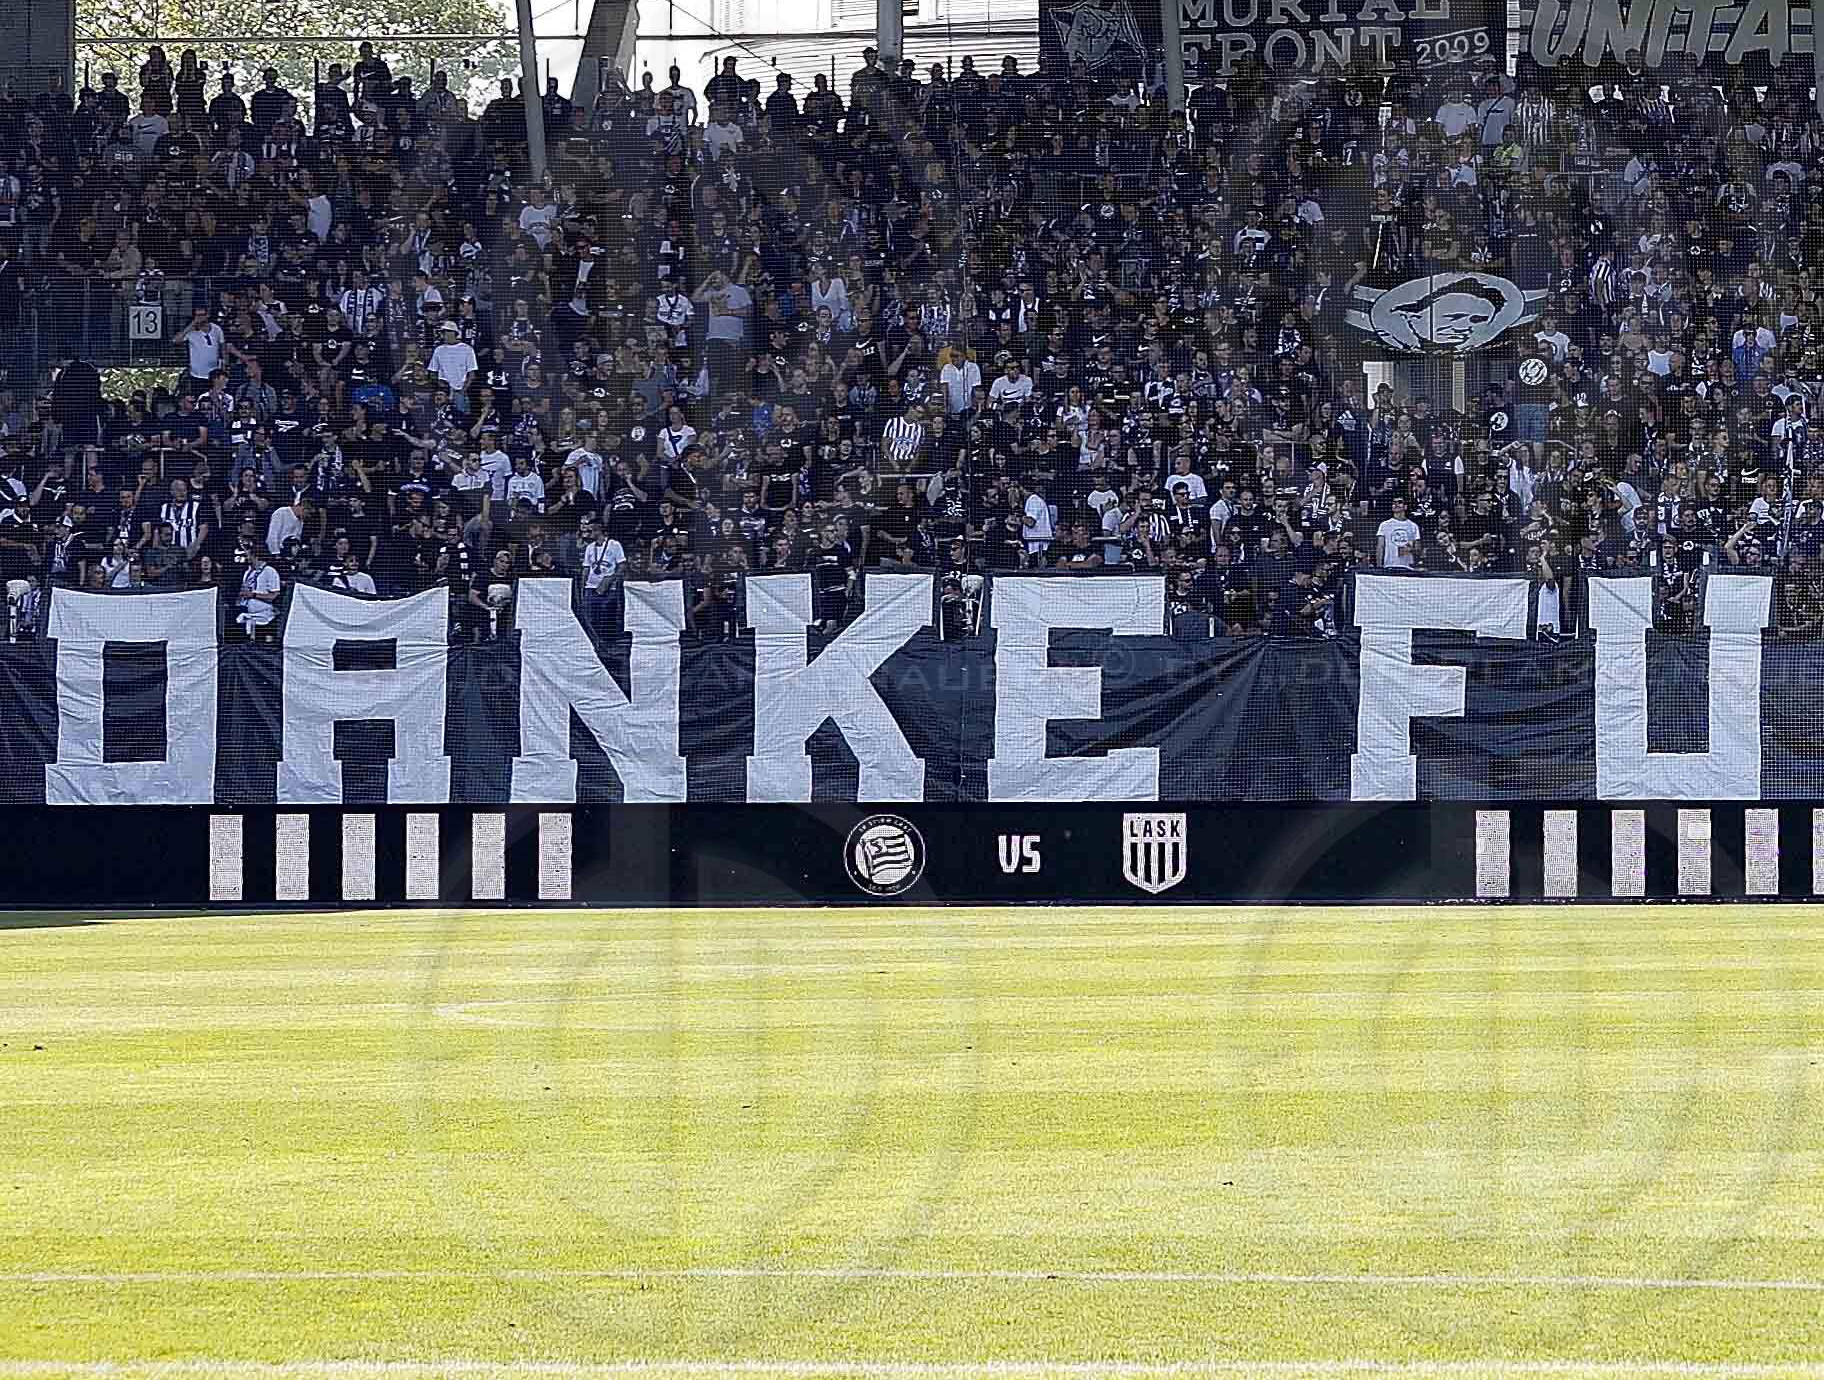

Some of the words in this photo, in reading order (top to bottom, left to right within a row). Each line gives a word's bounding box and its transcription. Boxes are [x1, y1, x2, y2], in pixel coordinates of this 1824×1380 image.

[1415, 30, 1492, 66] 2009
[132, 310, 159, 336] 13
[45, 571, 1166, 807] DANKE
[1128, 819, 1182, 837] LASK
[997, 834, 1041, 874] VS
